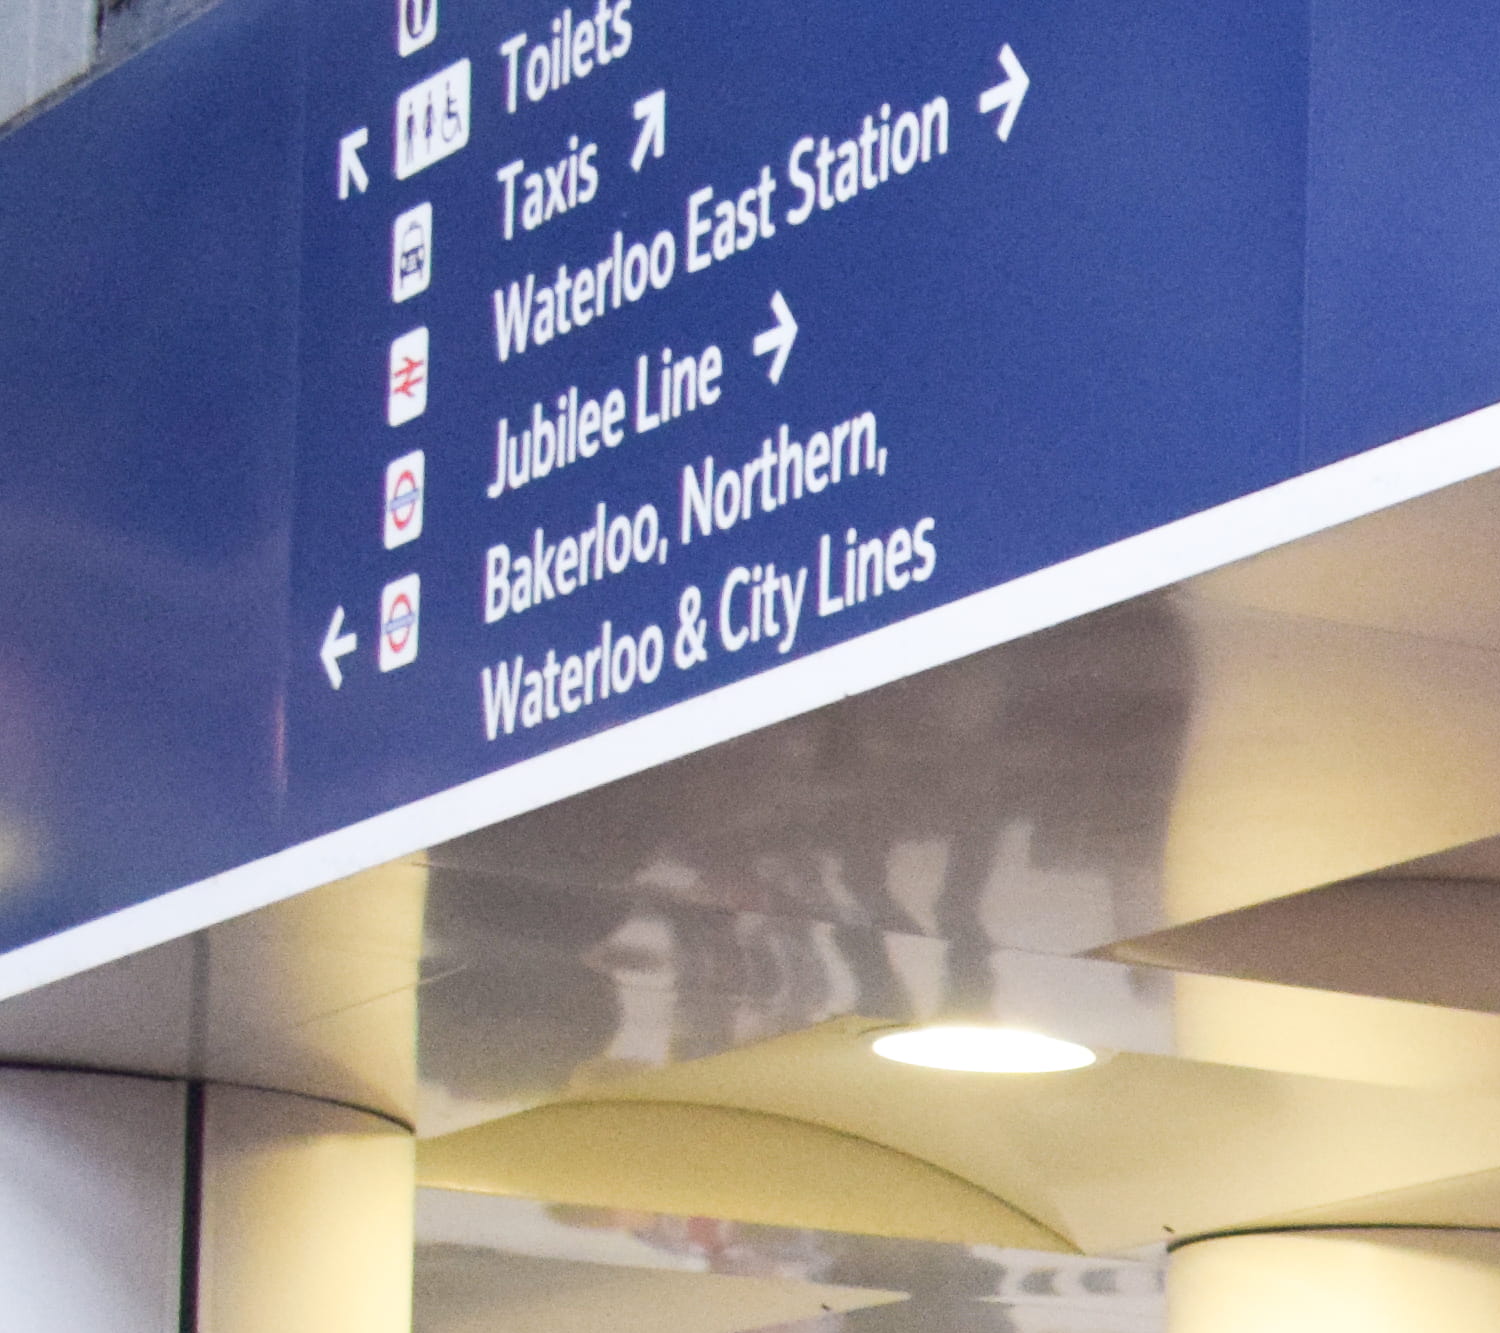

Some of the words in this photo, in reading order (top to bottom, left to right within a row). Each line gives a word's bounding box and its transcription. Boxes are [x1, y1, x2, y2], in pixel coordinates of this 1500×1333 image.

[500, 0, 633, 114] Toilets
[493, 230, 676, 362] Waterloo
[686, 165, 777, 273] East
[786, 96, 949, 226] Station
[496, 134, 599, 241] Taxis
[487, 383, 626, 499] Jubilee
[635, 345, 723, 434] Line
[484, 502, 669, 624] Bakerloo,
[681, 411, 888, 545] Northern,
[481, 620, 665, 741] Waterloo
[673, 585, 708, 670] &
[718, 562, 808, 654] City
[817, 516, 937, 617] Lines
